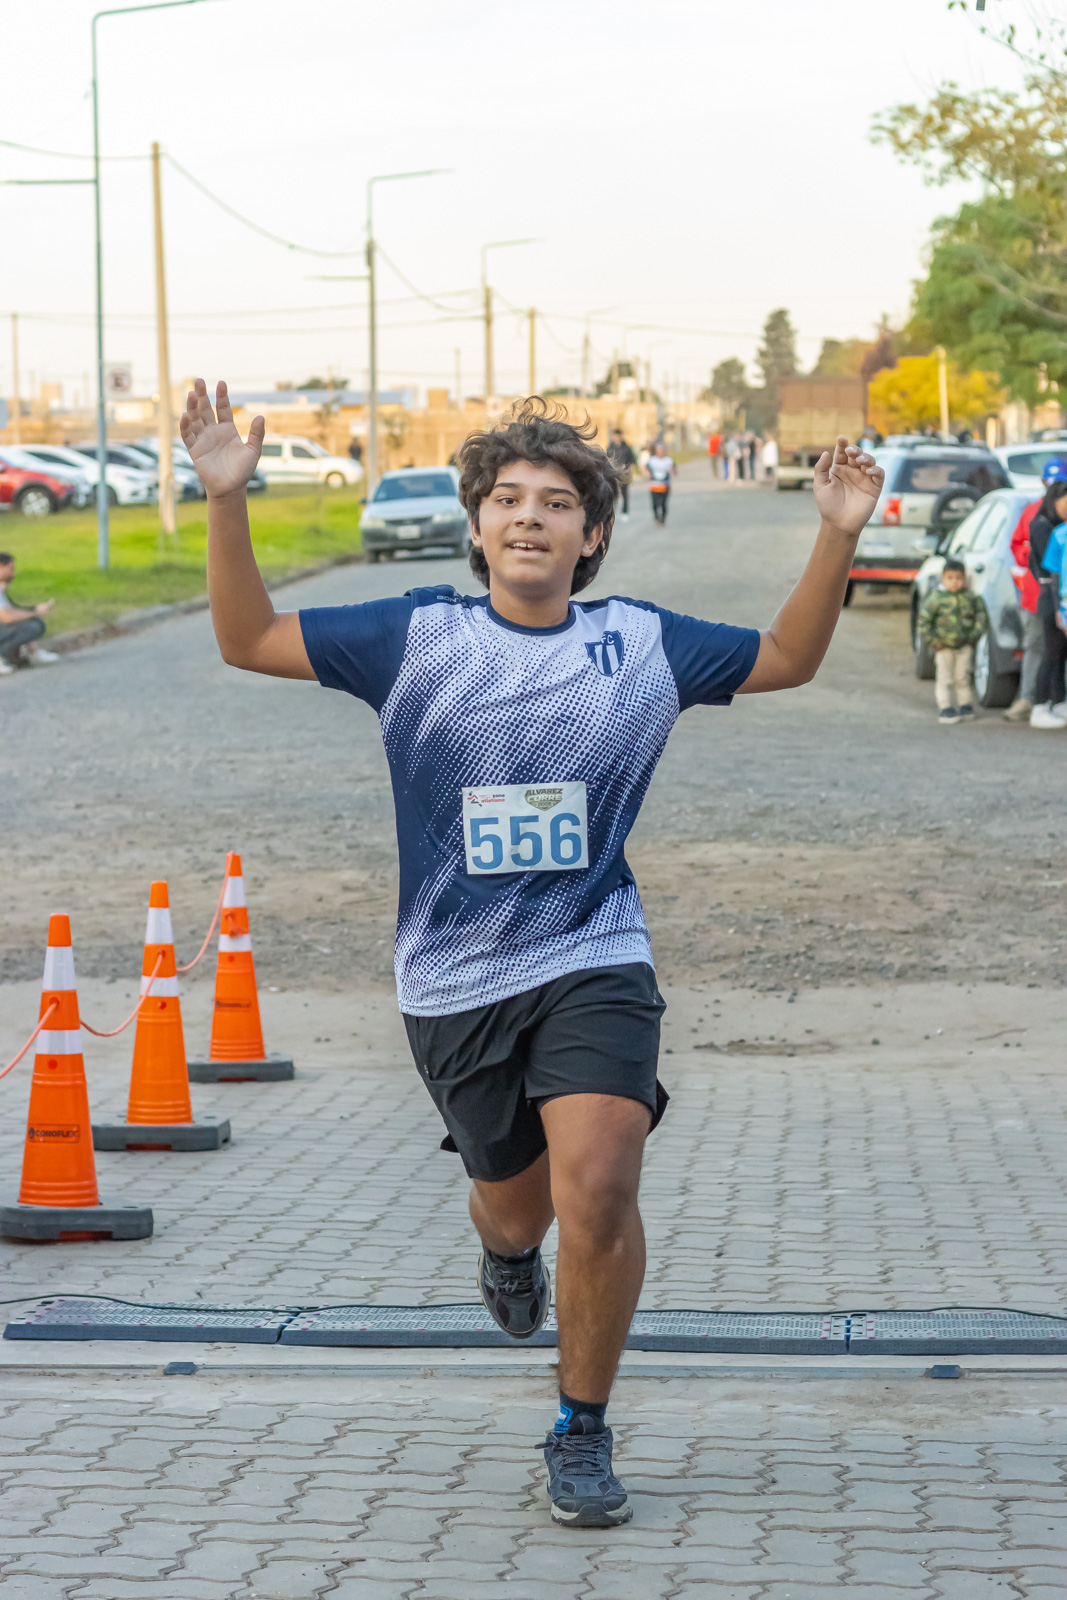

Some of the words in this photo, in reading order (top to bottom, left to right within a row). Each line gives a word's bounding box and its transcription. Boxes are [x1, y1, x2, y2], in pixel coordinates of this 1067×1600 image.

[525, 788, 564, 797] ALVAREZ
[527, 794, 563, 803] CORRE
[469, 812, 582, 870] 556
